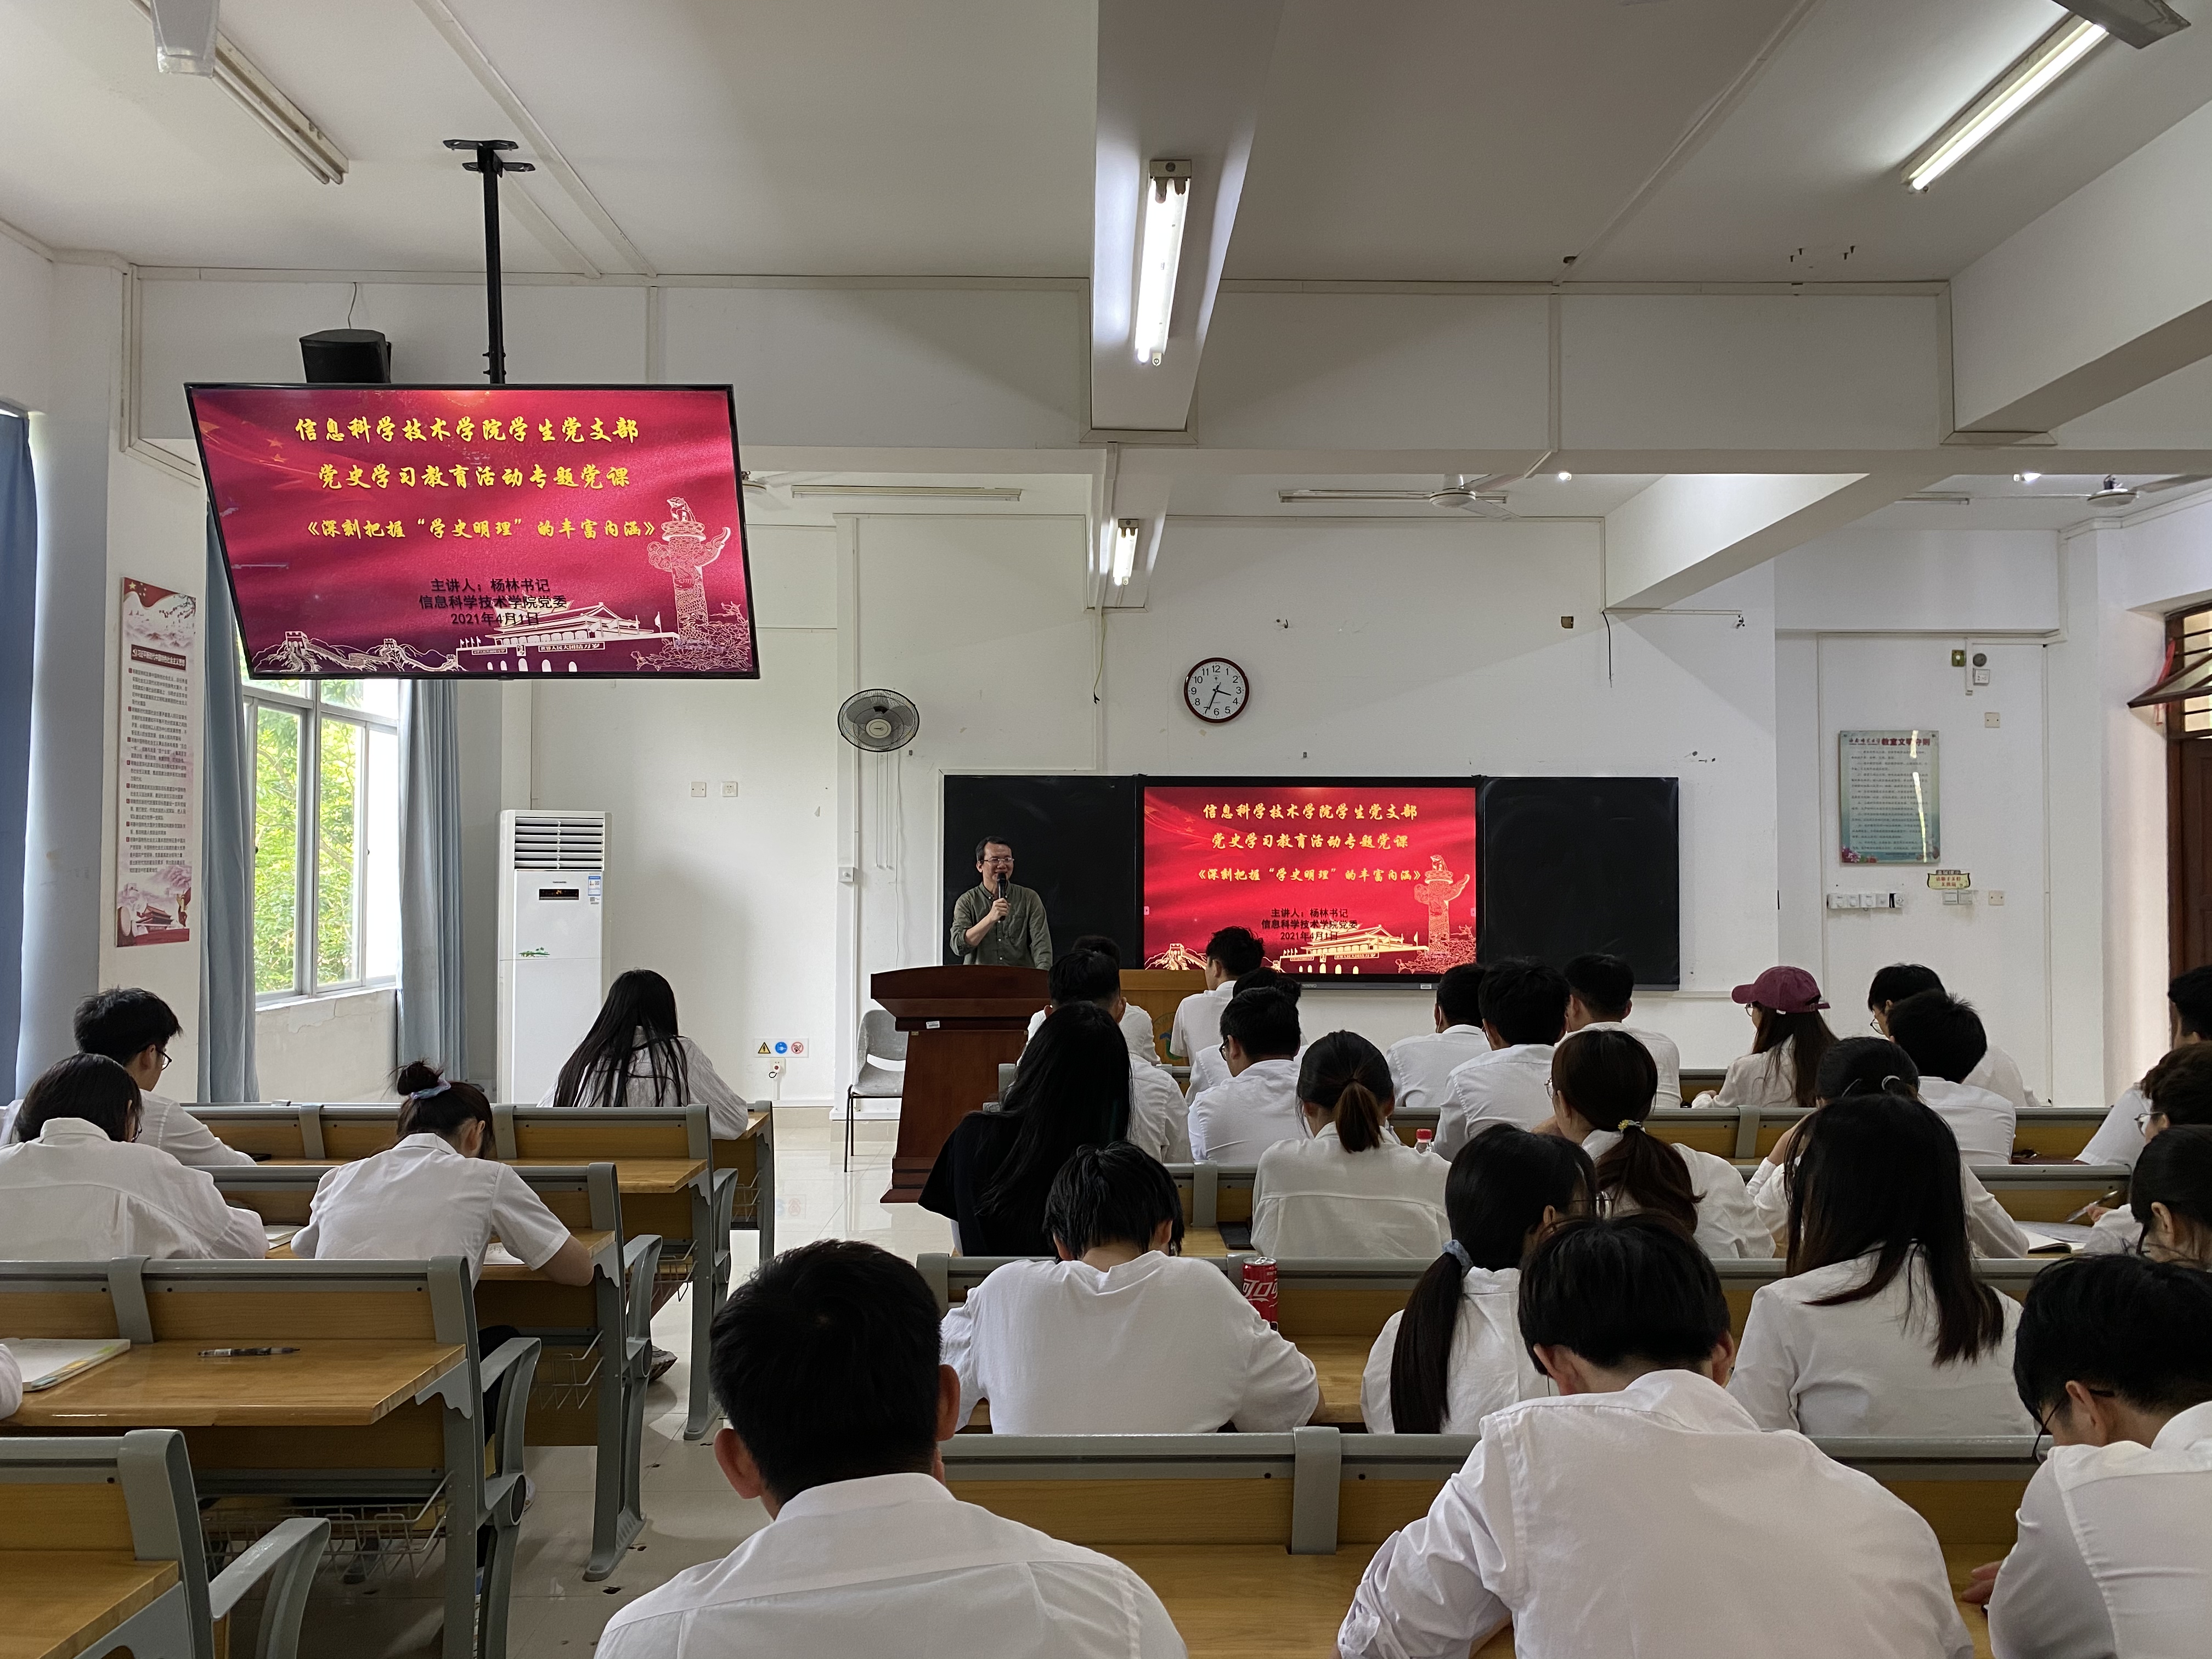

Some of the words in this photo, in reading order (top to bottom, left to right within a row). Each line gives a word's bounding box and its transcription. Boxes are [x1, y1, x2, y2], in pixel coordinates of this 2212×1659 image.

[295, 416, 639, 443] 信息科学技术学院学生党支部
[318, 464, 630, 489] 党史学习教育活动专题党课
[431, 578, 550, 592] 主讲人：杨林书记
[419, 595, 567, 610] 信息科学技术学院党委
[450, 612, 539, 625] 2021年4月1日
[1194, 698, 1200, 706] 8
[1203, 803, 1418, 821] 信息科学技术学院学生党支部
[1211, 832, 1409, 850] 党史学习教育活动专题党课
[1271, 908, 1348, 918] 主讲人：杨林书记
[1261, 919, 1358, 929] 信息科学技术学院党委
[1280, 932, 1338, 941] 2021年4月1日
